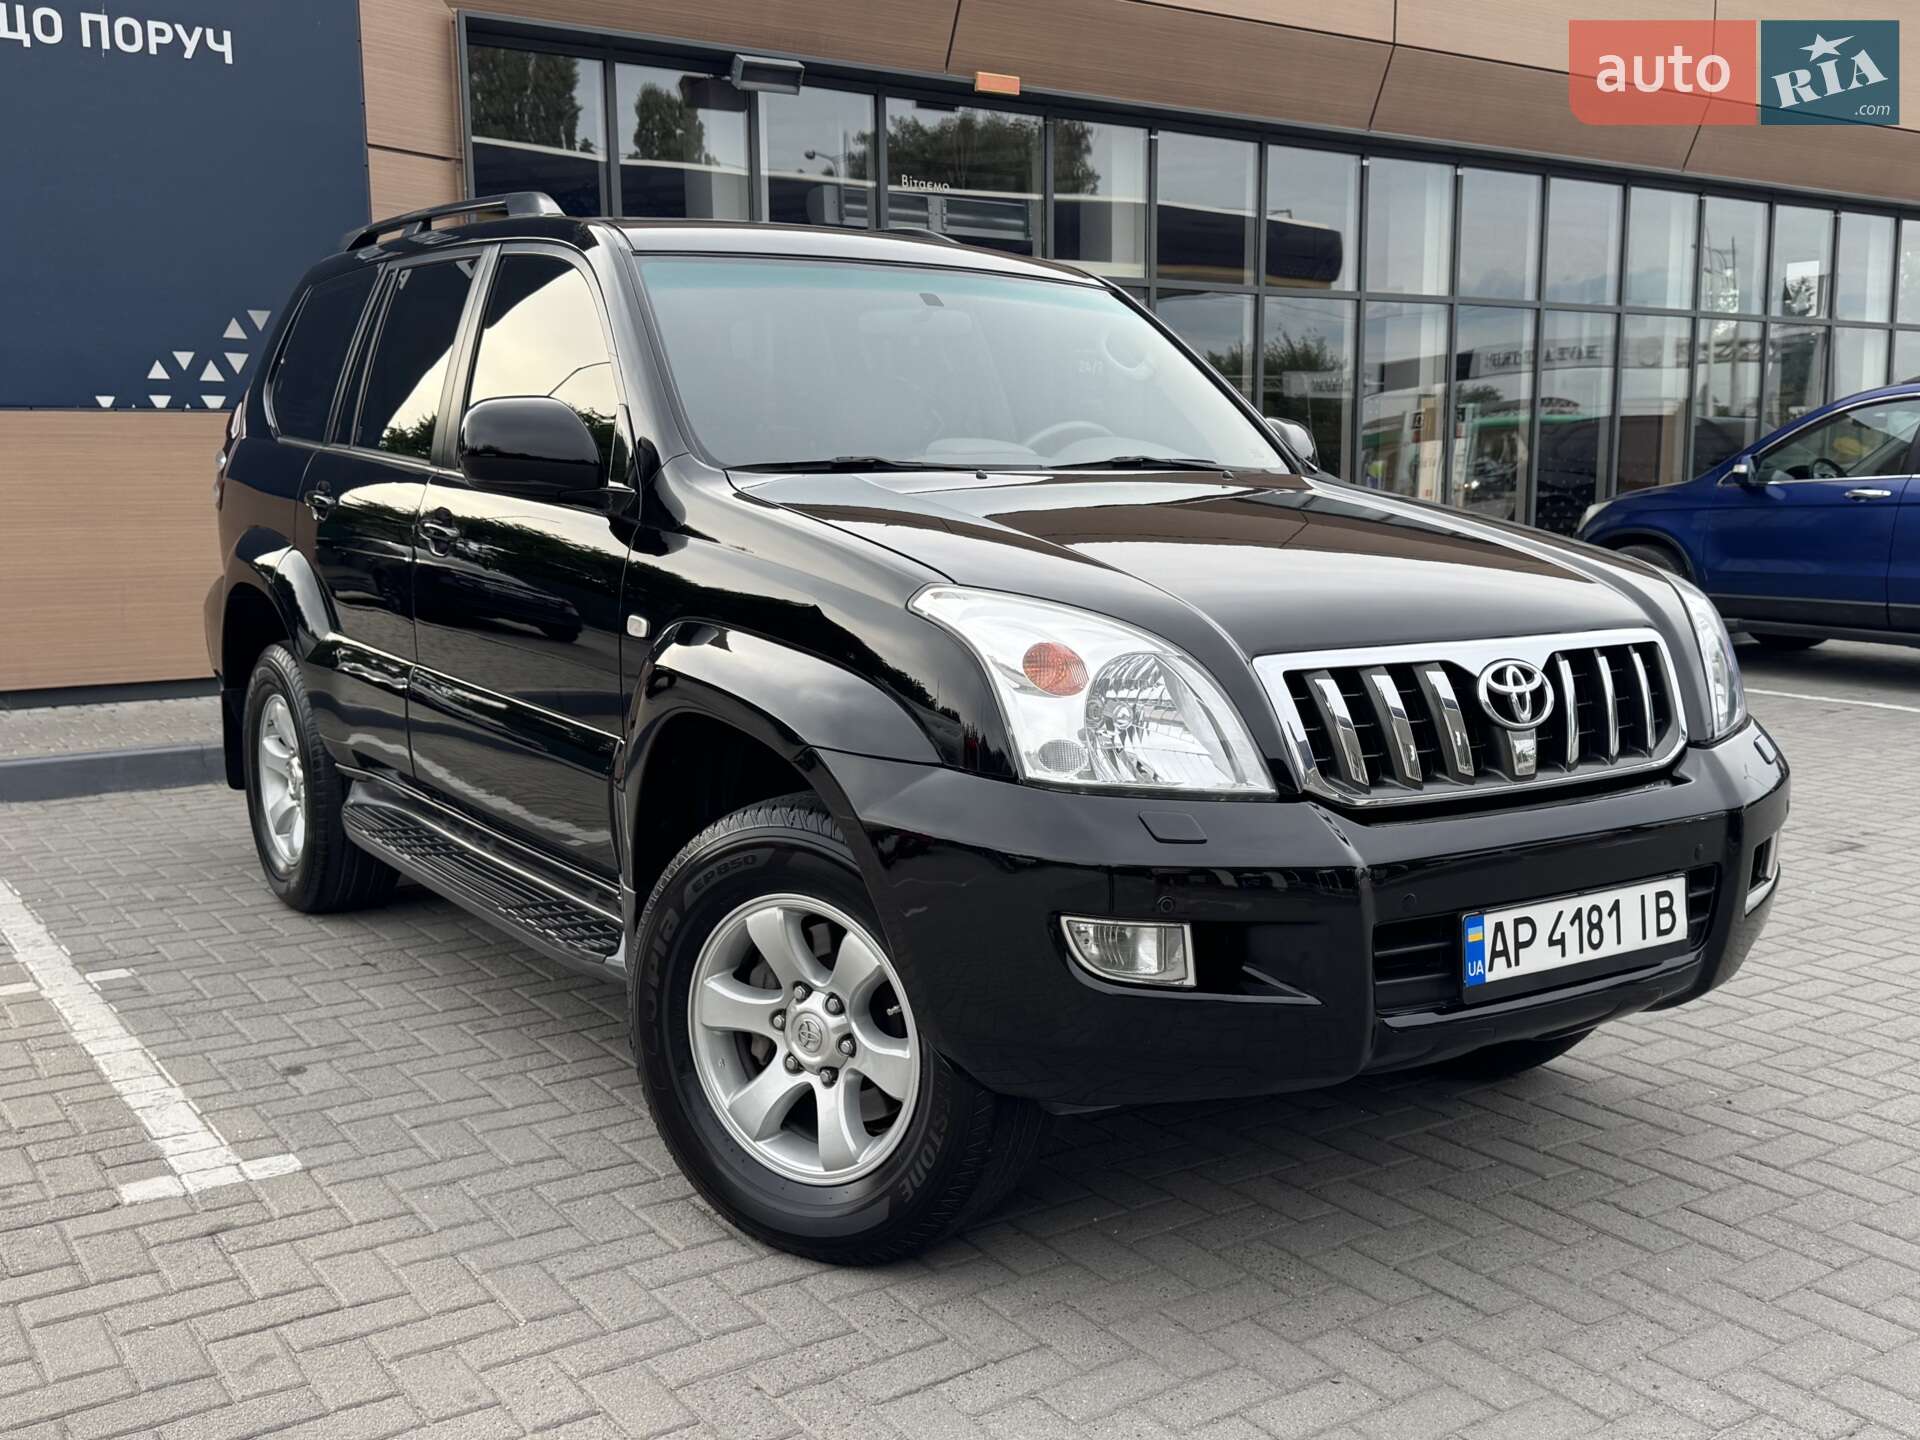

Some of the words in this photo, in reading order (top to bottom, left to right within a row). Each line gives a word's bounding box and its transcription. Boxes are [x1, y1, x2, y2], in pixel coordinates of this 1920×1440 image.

[80, 12, 233, 64] ПОРУЧ
[901, 174, 949, 193] Вітаємо
[1488, 916, 1537, 972] AP
[1548, 899, 1622, 958] 4181
[1641, 890, 1677, 941] IB
[1468, 960, 1485, 976] UA
